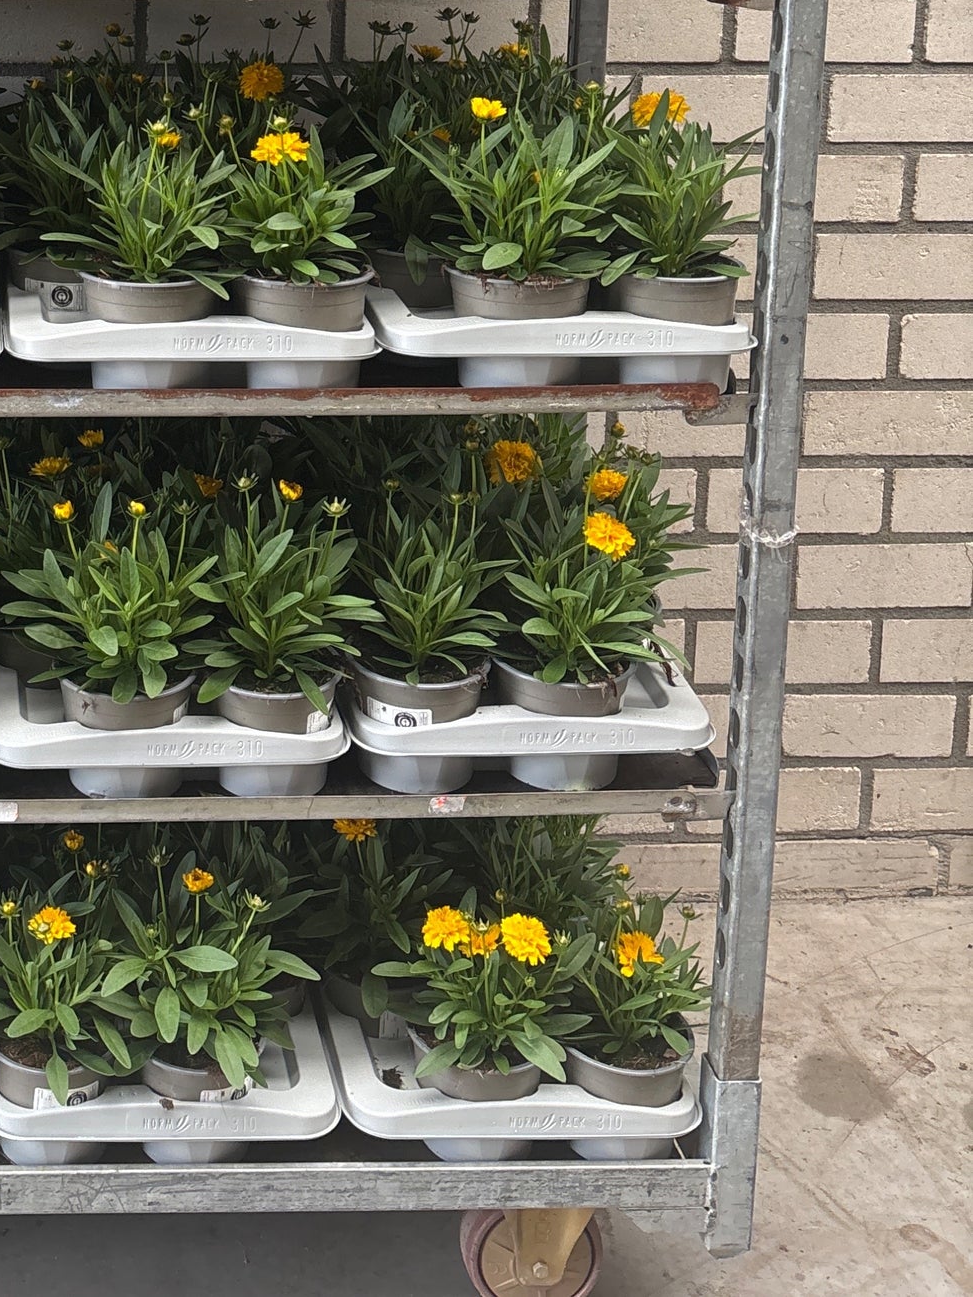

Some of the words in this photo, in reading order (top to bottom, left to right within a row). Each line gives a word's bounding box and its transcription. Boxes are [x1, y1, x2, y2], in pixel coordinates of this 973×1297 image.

[174, 337, 205, 351] NORM
[267, 335, 293, 352] 310
[556, 334, 587, 347] NORM
[647, 331, 674, 347] 310
[520, 732, 551, 744] NORM
[610, 730, 635, 746] 310
[148, 744, 178, 757] NORM
[237, 740, 263, 757] 310
[143, 1118, 173, 1130] NORM
[233, 1117, 256, 1132] 310
[509, 1117, 540, 1128] NORM
[597, 1115, 622, 1130] 310
